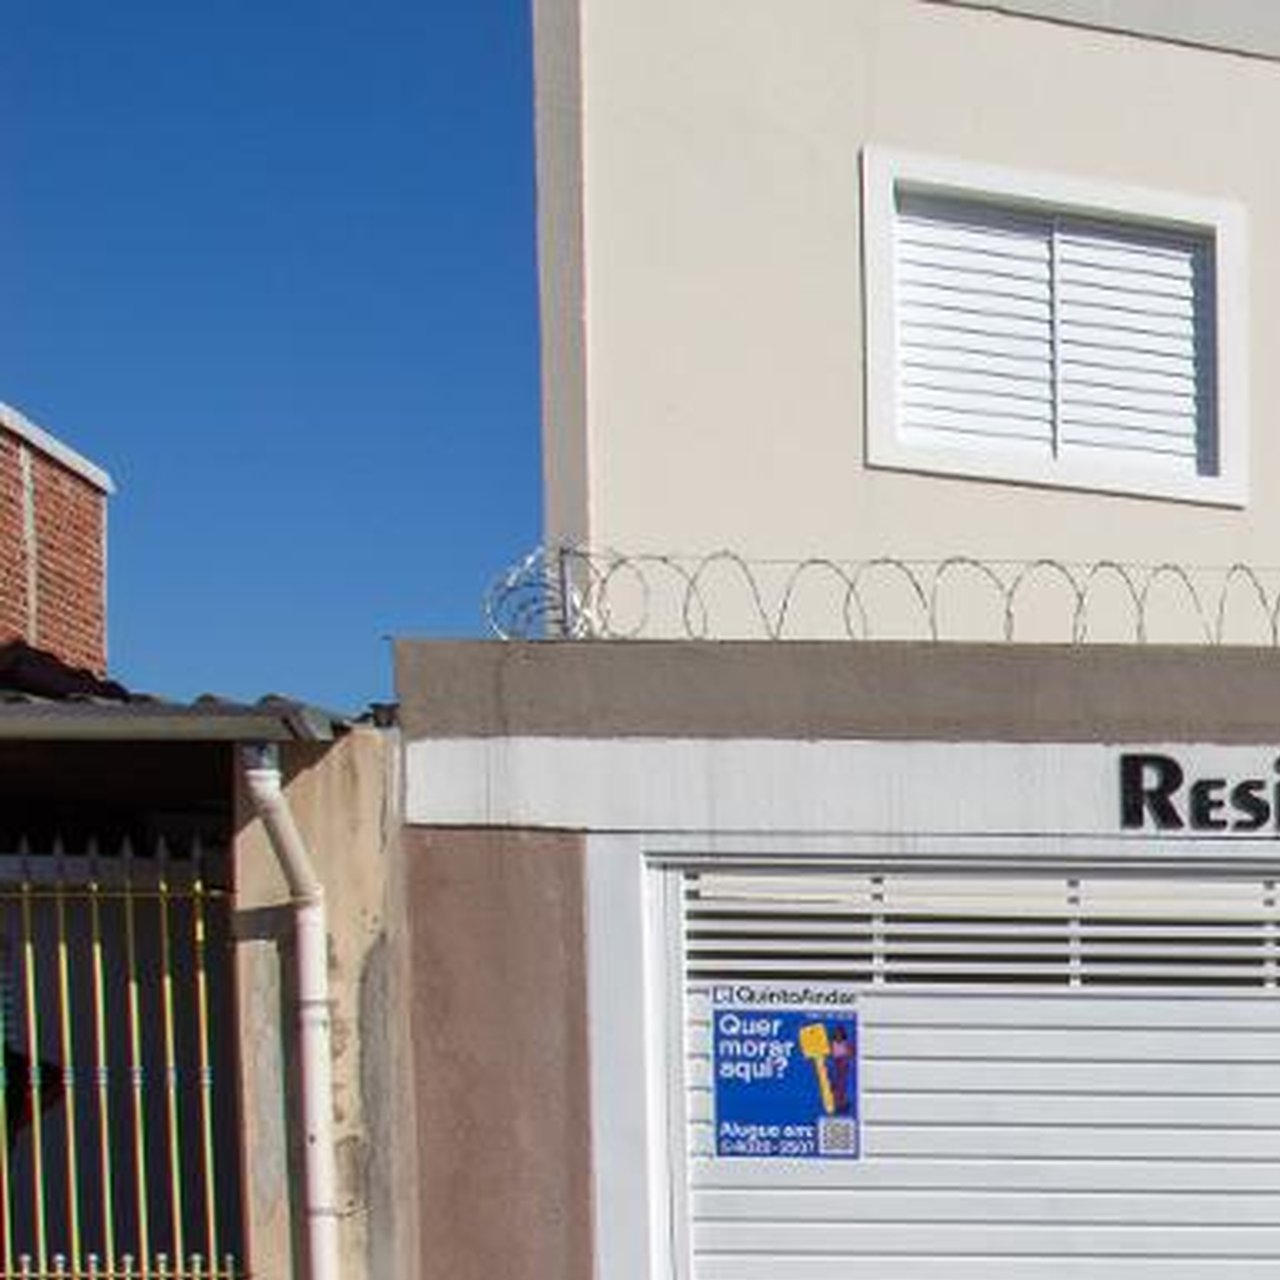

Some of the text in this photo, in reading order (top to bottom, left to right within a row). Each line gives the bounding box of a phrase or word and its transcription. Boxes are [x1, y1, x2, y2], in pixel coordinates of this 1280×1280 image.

[719, 1013, 784, 1036] Quer
[719, 1040, 795, 1057] morar
[719, 1056, 789, 1083] aqui?
